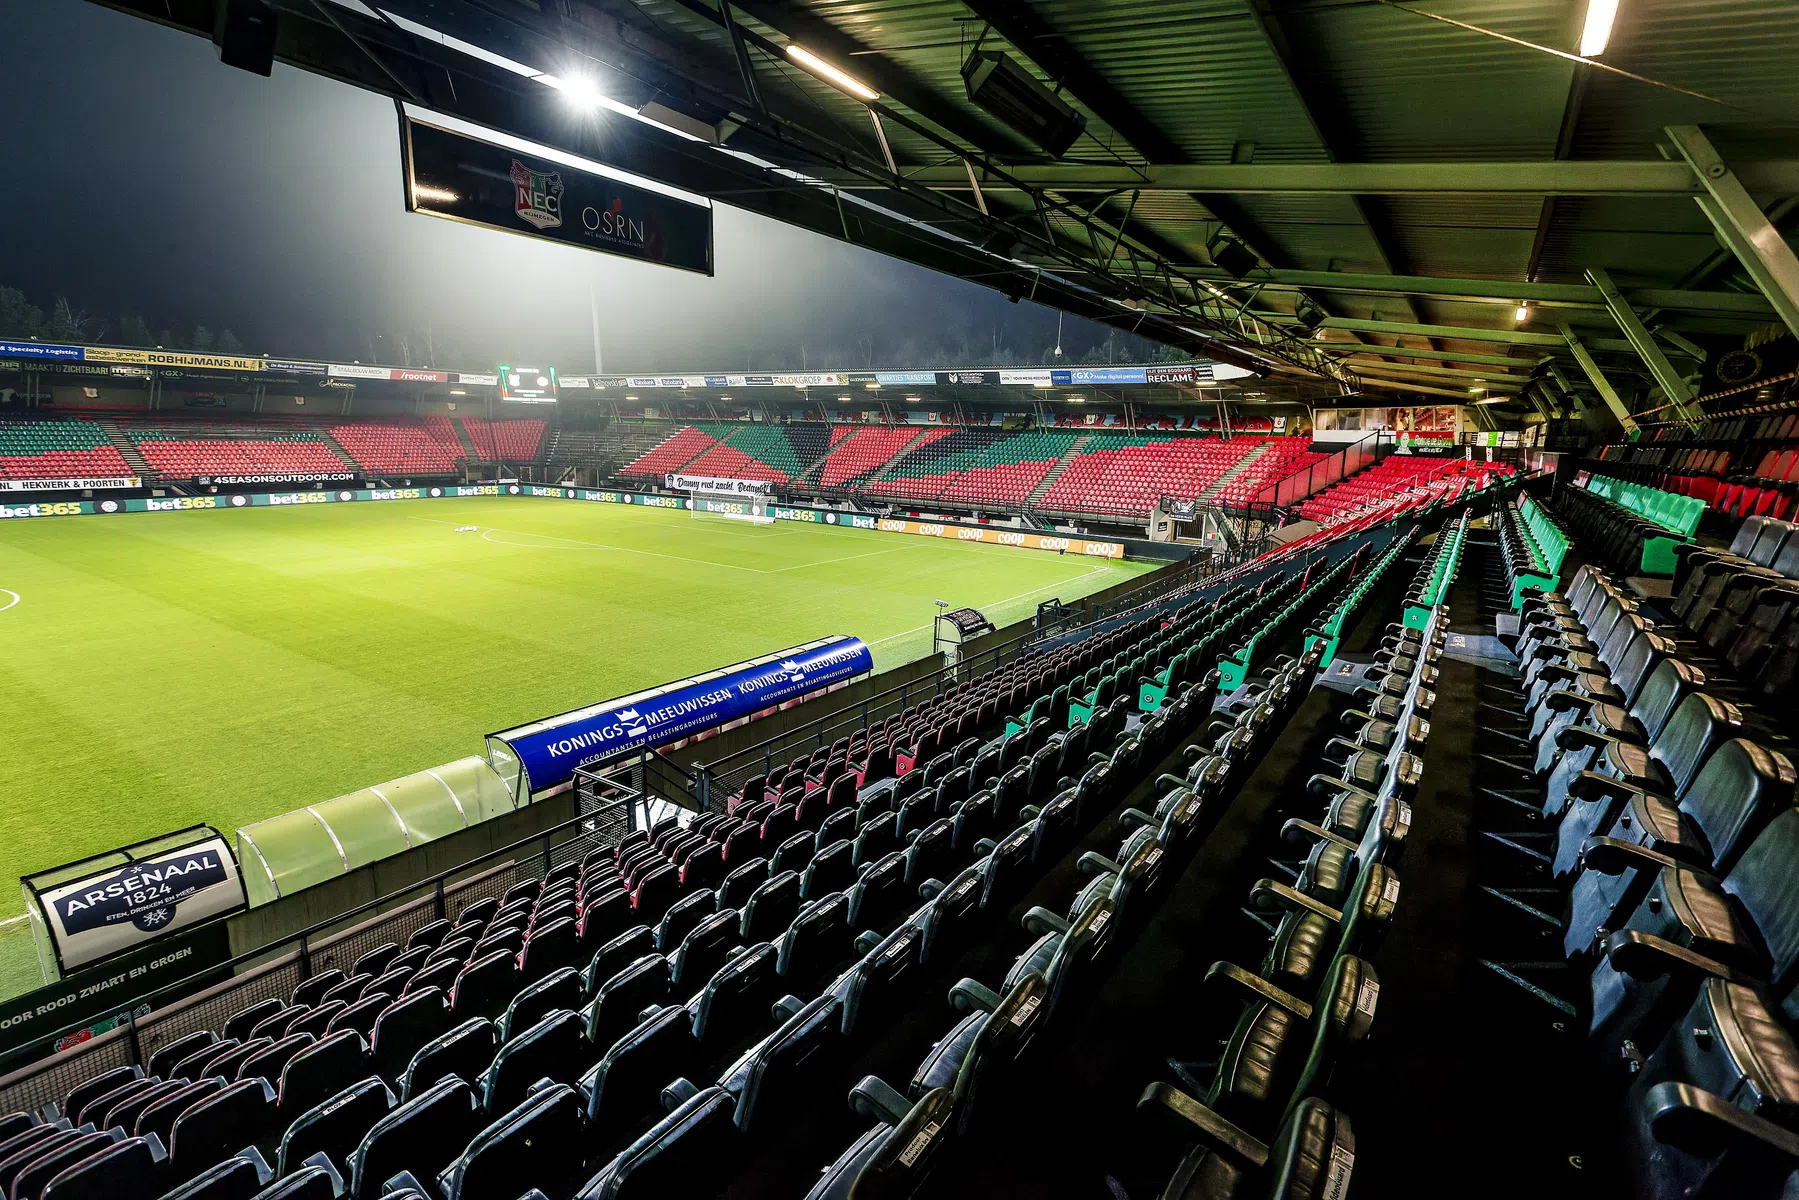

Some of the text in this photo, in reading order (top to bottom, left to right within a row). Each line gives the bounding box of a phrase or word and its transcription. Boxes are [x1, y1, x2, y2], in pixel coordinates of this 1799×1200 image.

[519, 187, 558, 212] NEC
[523, 211, 555, 222] NIJMEGEN
[582, 206, 644, 243] OSRN
[7, 346, 44, 355] Specialty
[45, 348, 78, 356] Logistics
[148, 354, 249, 369] ROBHIJMANS.NL
[24, 362, 53, 372] MAAKT
[55, 364, 61, 373] U
[63, 365, 108, 375] ZICHTBAAR!
[779, 375, 822, 385] KLOKGROEP
[904, 374, 935, 382] TRANSPORT
[1147, 373, 1194, 383] RECLAME
[22, 480, 71, 489] HEKWERK
[73, 480, 81, 488] &
[83, 479, 125, 488] POORTEN
[213, 473, 354, 484] 4SEASONSOUTDOOR.COM
[371, 488, 420, 500] bet365
[457, 485, 499, 496] bet365
[532, 486, 561, 497] bet365
[585, 490, 617, 502] bet365
[146, 496, 216, 511] bet365
[269, 492, 327, 505] bet365
[643, 495, 678, 508] bet365
[0, 502, 82, 518] bet365
[707, 501, 743, 514] bet365
[775, 506, 816, 522] bet365
[881, 519, 906, 532] coop
[919, 523, 944, 536] coop
[957, 528, 984, 541] coop
[997, 532, 1025, 546] coop
[1040, 535, 1070, 550] coop
[1085, 541, 1118, 556] coop
[737, 647, 863, 695] KONINGS MEEUWISSEN
[760, 685, 796, 702] ACCOUNTANTS
[805, 666, 853, 689] BELASTINGADVISEURS
[546, 688, 734, 758] KONINGS MEEUWISSEN
[579, 711, 718, 766] ACCOUNTANTS EN BELASTINGADVISEURS
[67, 855, 217, 917] ARSENAAL
[123, 882, 172, 908] 1824
[106, 886, 196, 921] ETEN, DRINKEN EN MEER
[36, 993, 77, 1015] ROOD
[79, 973, 126, 999] ZWART
[129, 964, 148, 980] EN
[150, 946, 193, 970] GROEN
